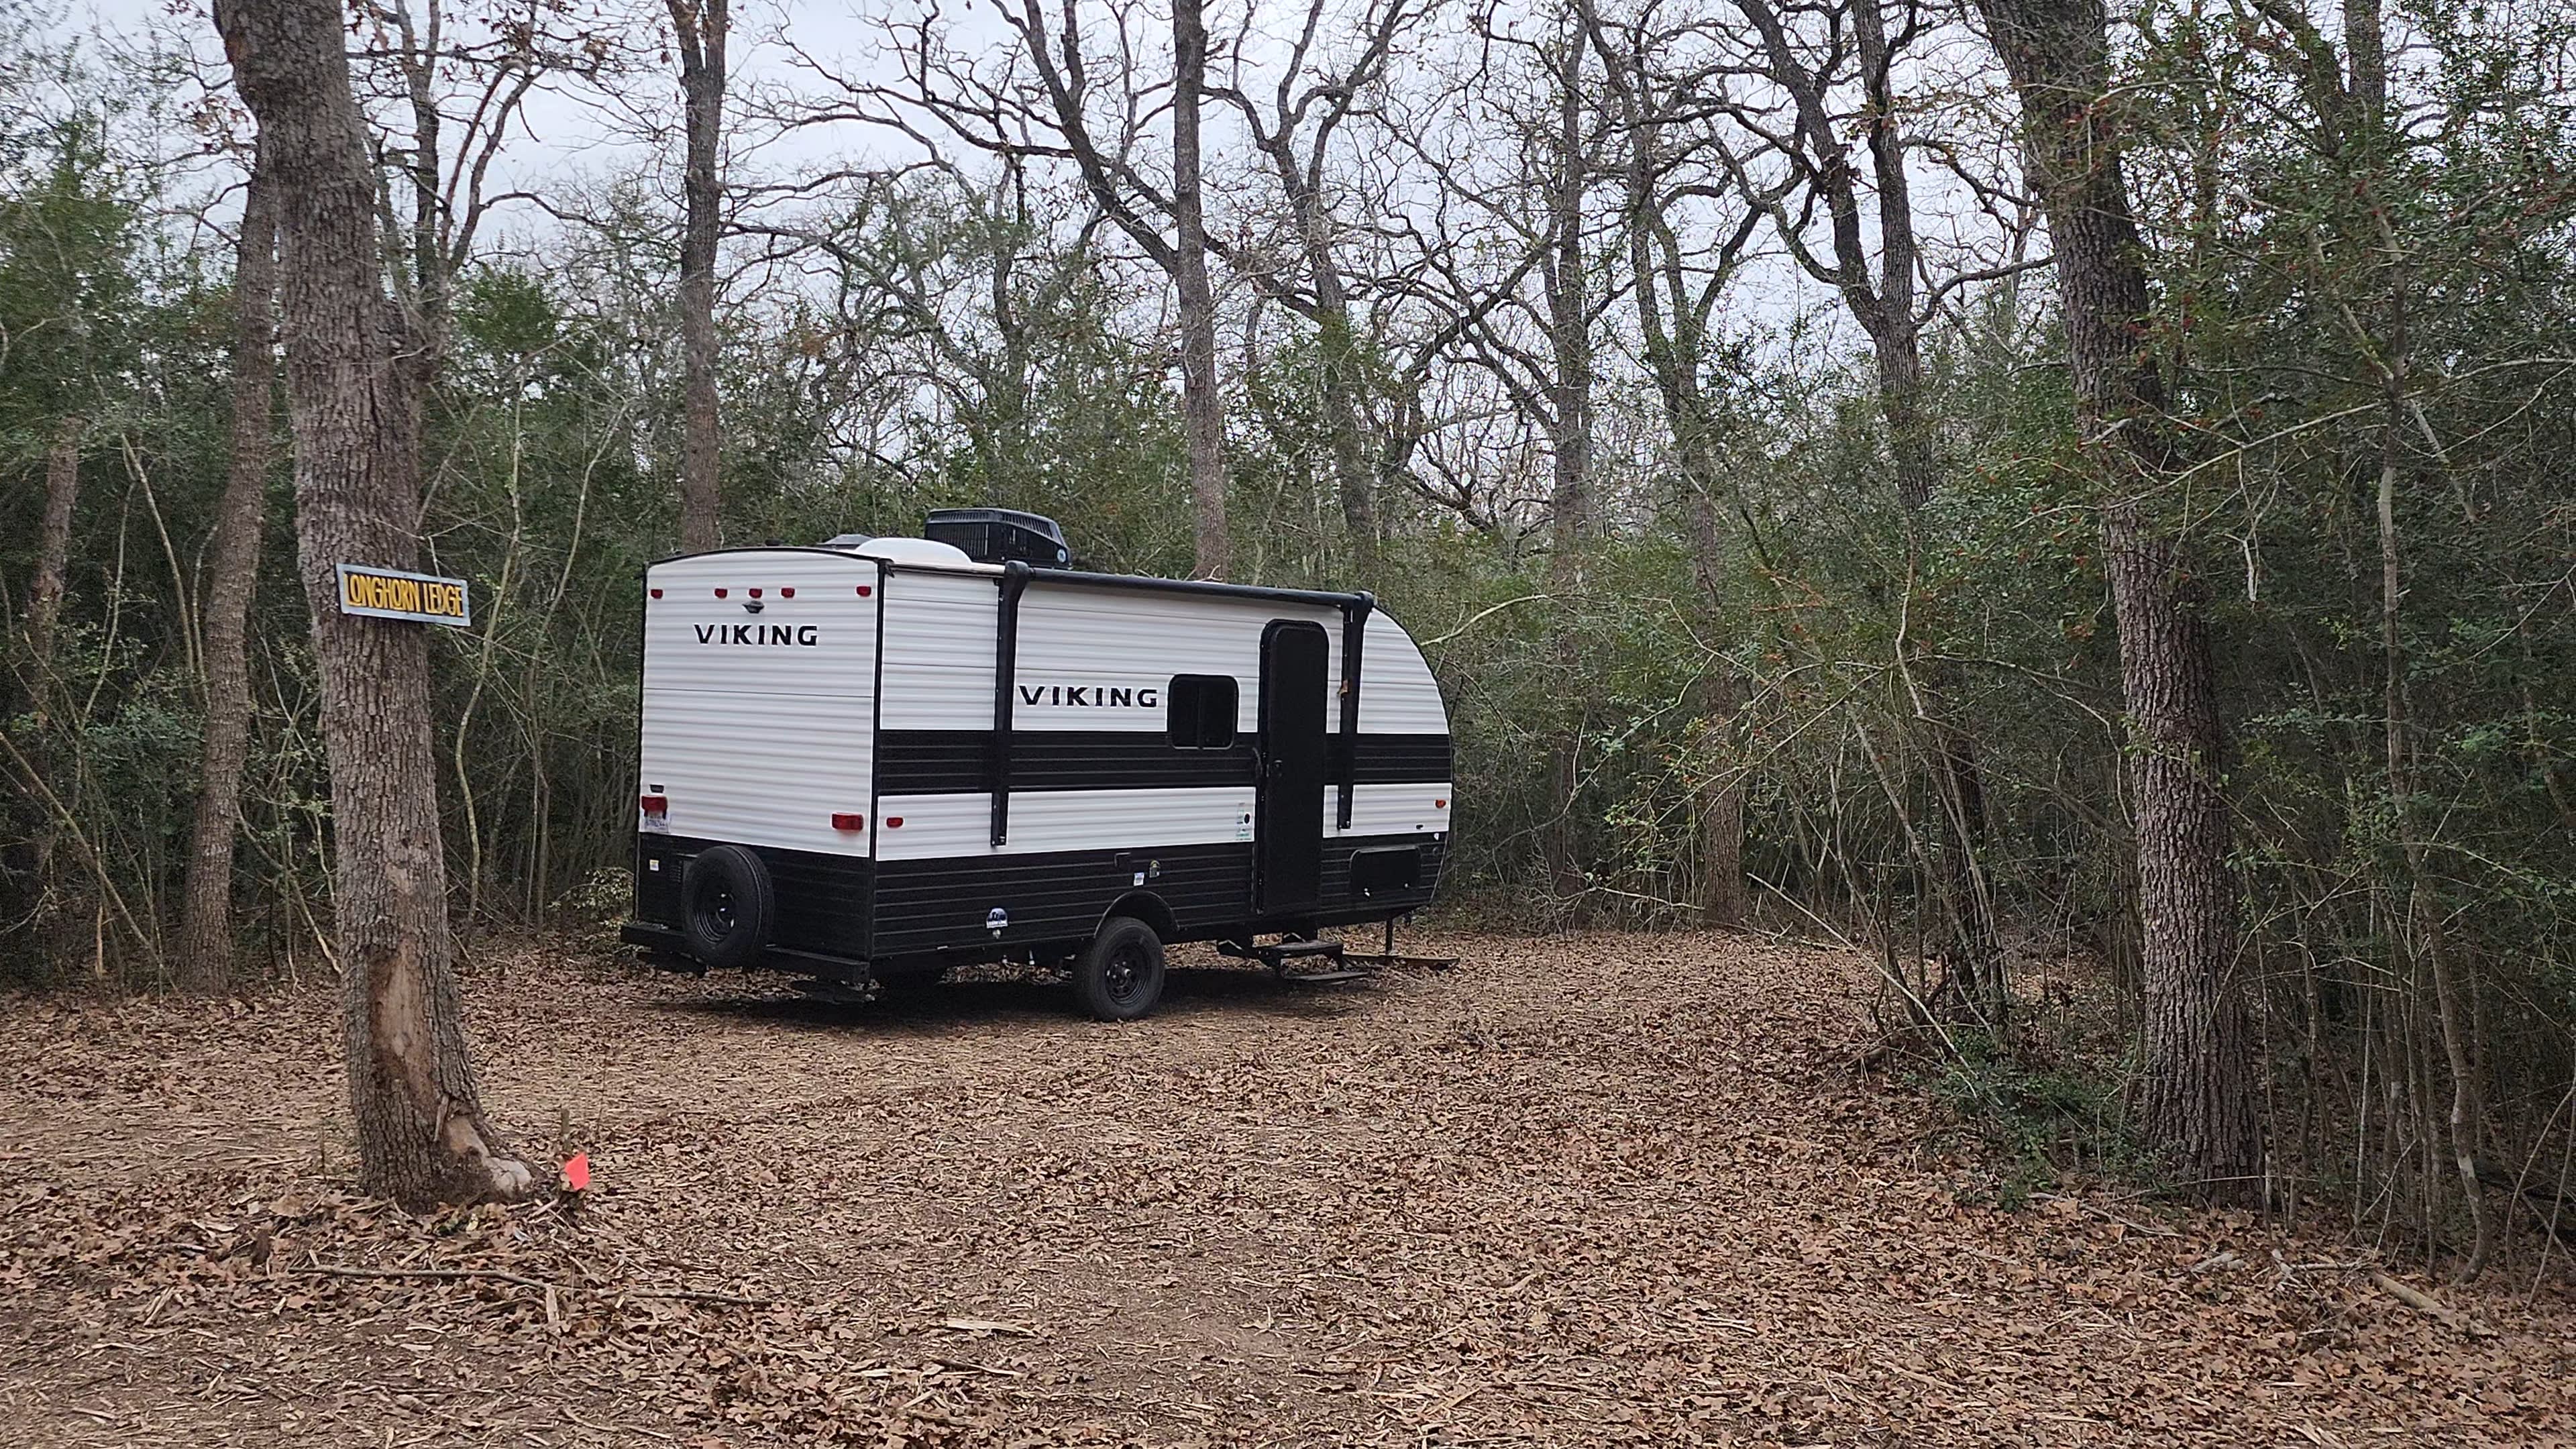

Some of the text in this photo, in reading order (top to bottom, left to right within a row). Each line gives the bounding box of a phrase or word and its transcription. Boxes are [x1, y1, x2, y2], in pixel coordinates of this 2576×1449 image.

[343, 573, 464, 616] LONGHORN LEDGE
[694, 624, 818, 647] VIKING
[1018, 685, 1157, 708] VIKING
